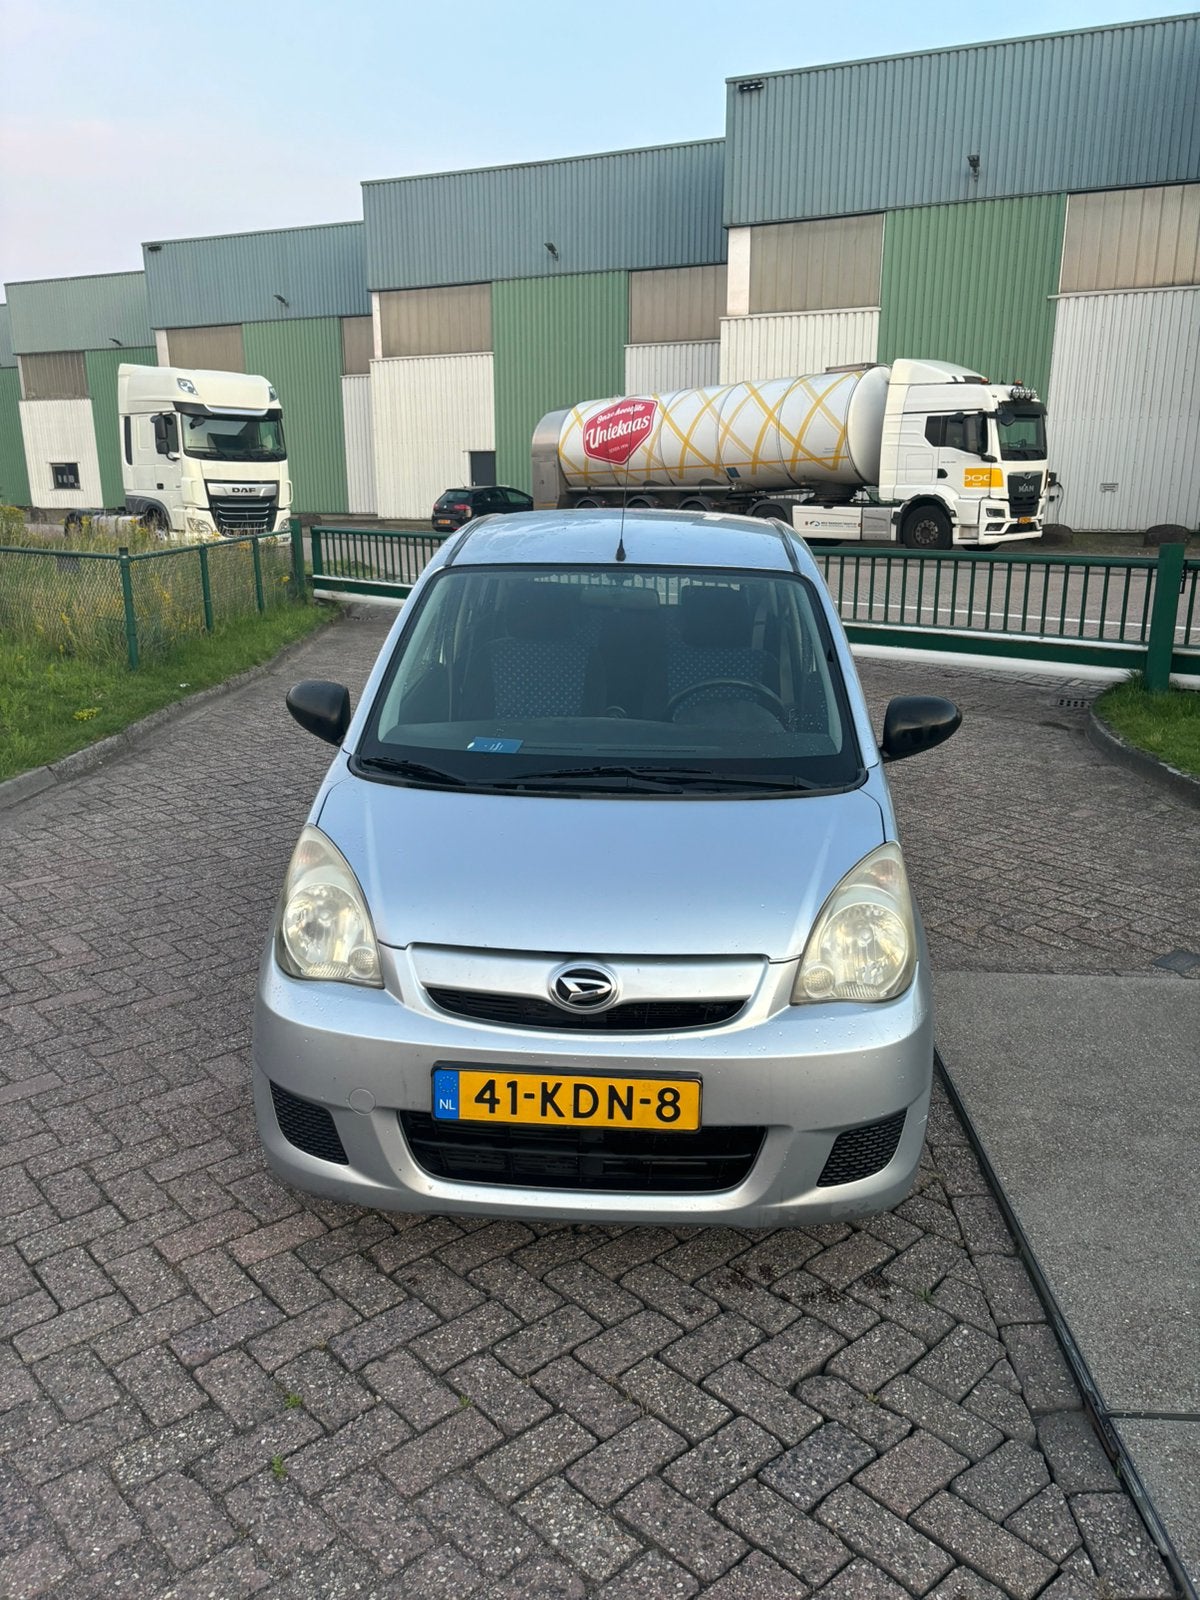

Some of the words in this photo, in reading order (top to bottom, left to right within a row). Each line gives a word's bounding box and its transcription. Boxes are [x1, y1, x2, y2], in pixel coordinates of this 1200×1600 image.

[586, 415, 651, 449] Uniekaas
[1019, 485, 1035, 493] MAN
[439, 1098, 456, 1110] NL
[474, 1079, 681, 1123] 41-KDN-8
